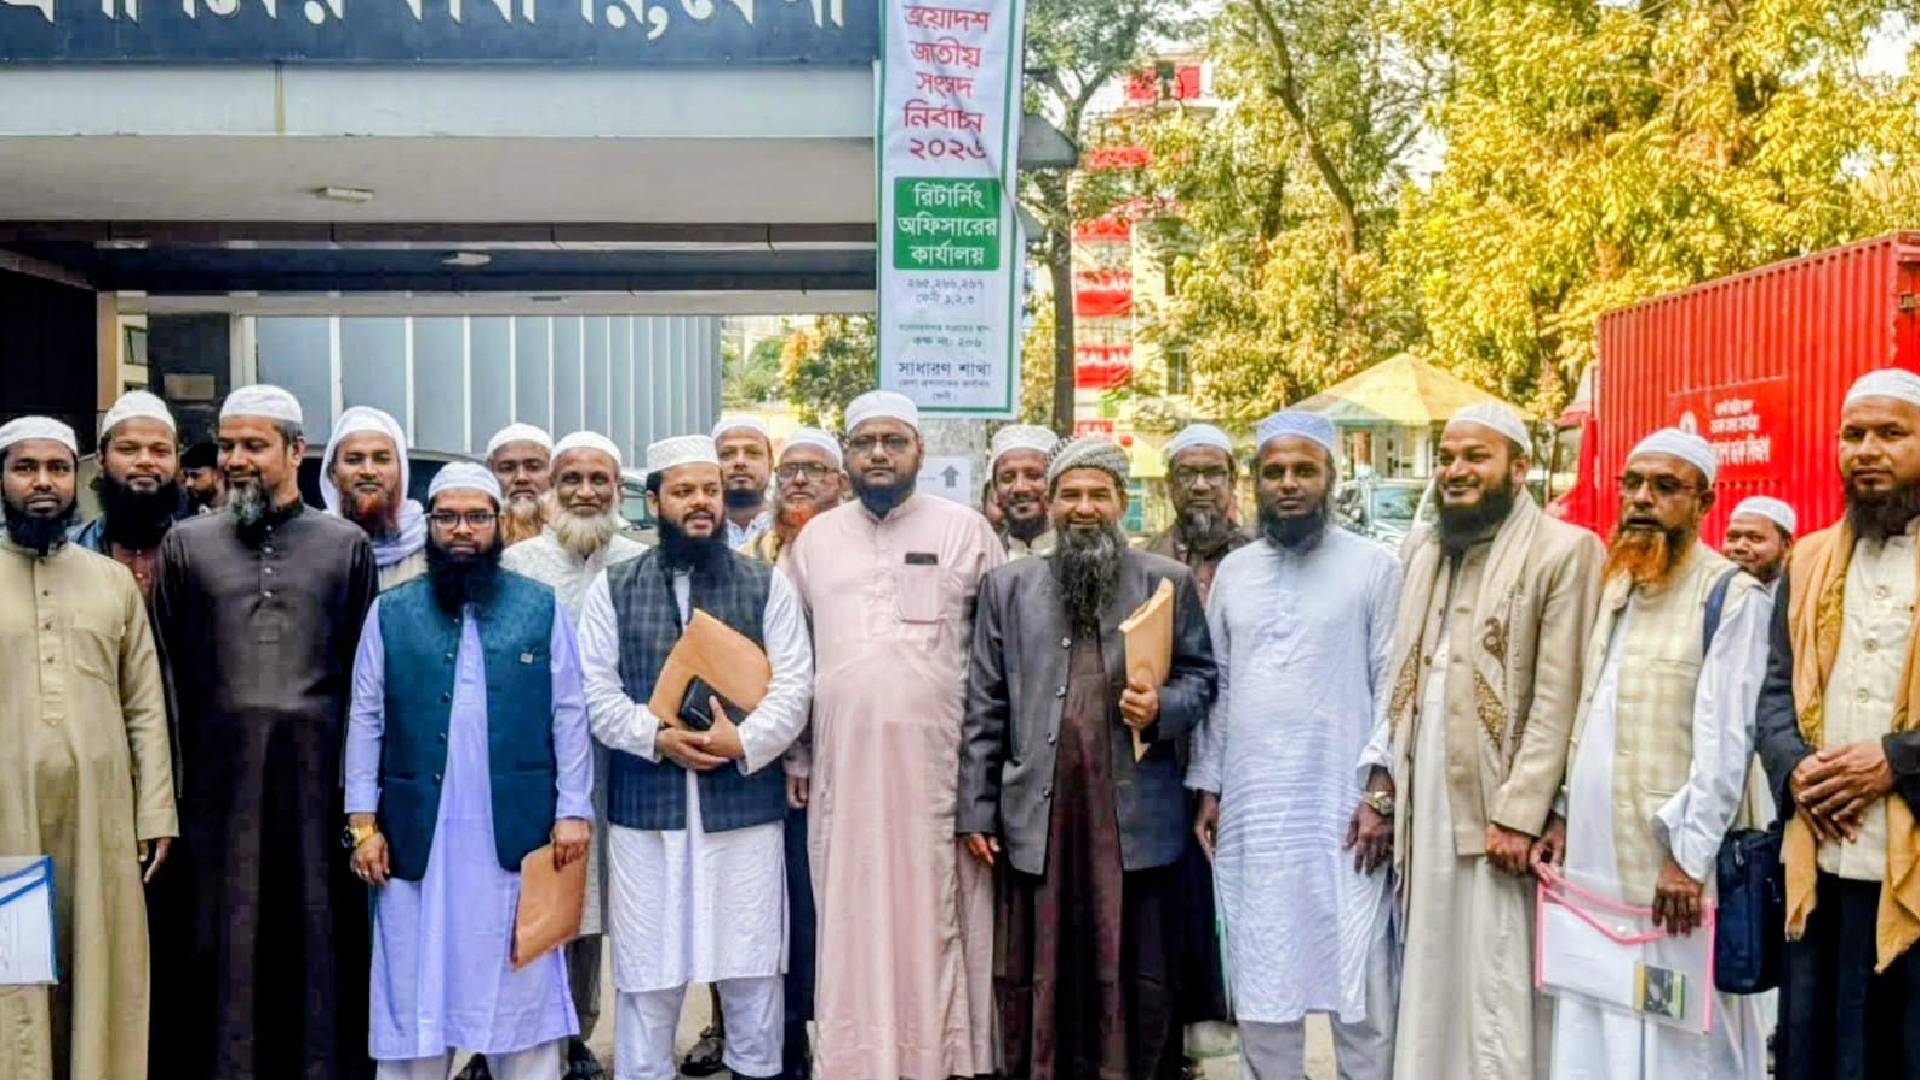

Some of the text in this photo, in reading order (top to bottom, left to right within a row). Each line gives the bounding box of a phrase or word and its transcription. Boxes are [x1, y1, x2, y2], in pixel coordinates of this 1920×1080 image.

[903, 5, 991, 33] ত্রয়োদশ
[909, 36, 983, 70] জাতীয়
[910, 138, 987, 160] ২০২৬
[912, 182, 985, 209] রিটার্নিং
[897, 211, 997, 237] অফিসারের
[907, 238, 985, 266] কার্যালয়
